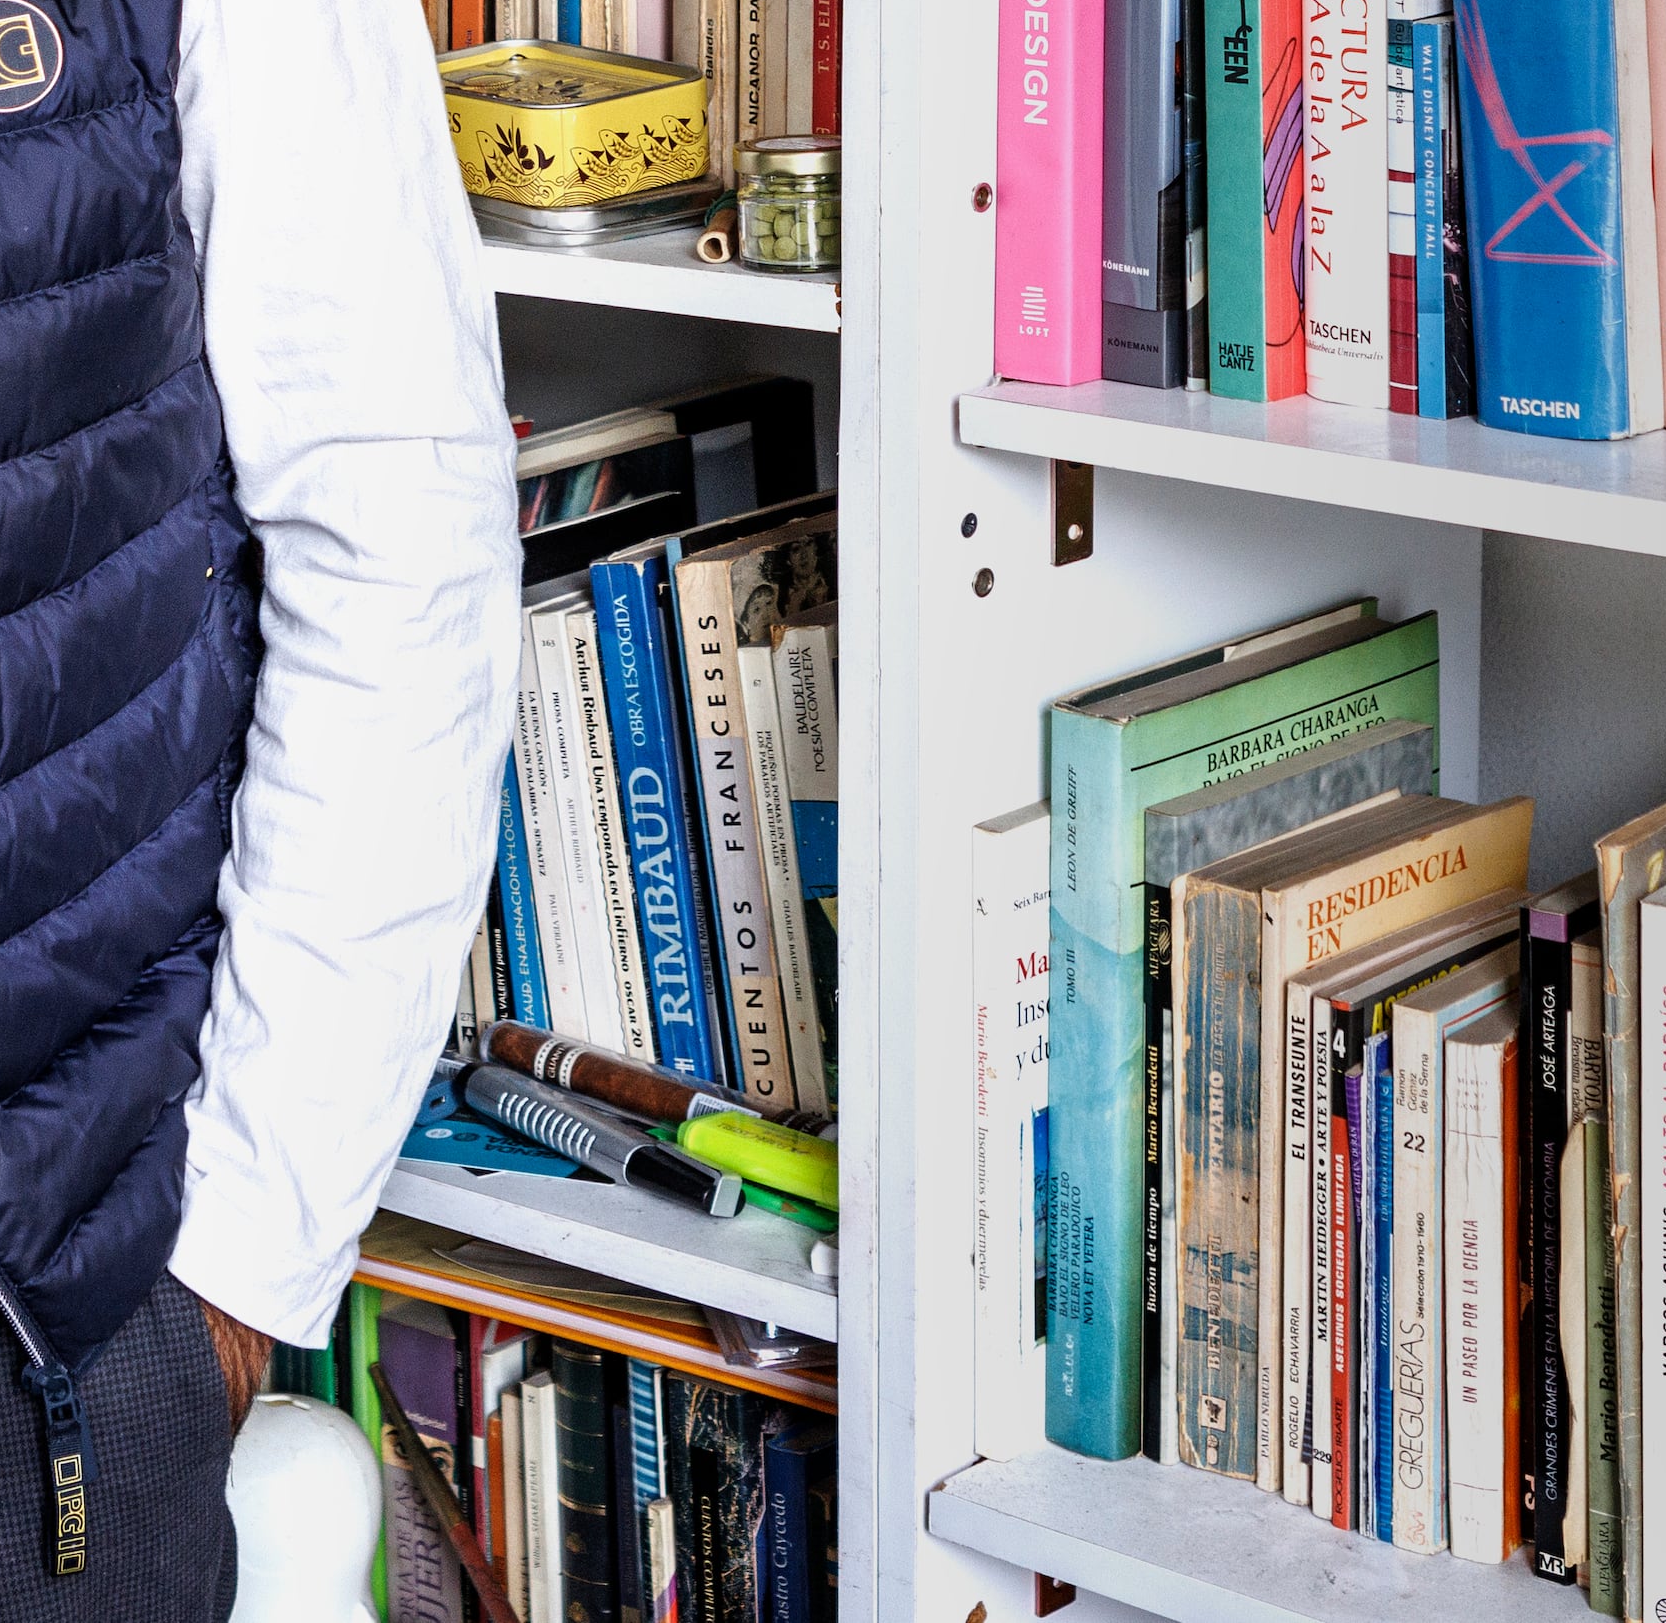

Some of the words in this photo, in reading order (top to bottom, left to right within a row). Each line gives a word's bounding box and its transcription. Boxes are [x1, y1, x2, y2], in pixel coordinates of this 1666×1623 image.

[748, 32, 760, 126] NICANOR
[1308, 319, 1373, 346] TASCHEN
[1500, 396, 1580, 420] TASCHEN
[613, 594, 642, 691] ESCOGIDA
[626, 694, 647, 747] OBRA
[786, 647, 810, 735] BAUDELAIRE
[1207, 729, 1285, 773] BARBARA
[1290, 694, 1379, 741] CHARANGA
[699, 615, 746, 854] FRANCESES
[629, 767, 694, 1028] RIMBAUD
[1307, 845, 1468, 930] RESIDENCIA
[1307, 924, 1343, 962] EN
[733, 899, 775, 1097] CUENTOS
